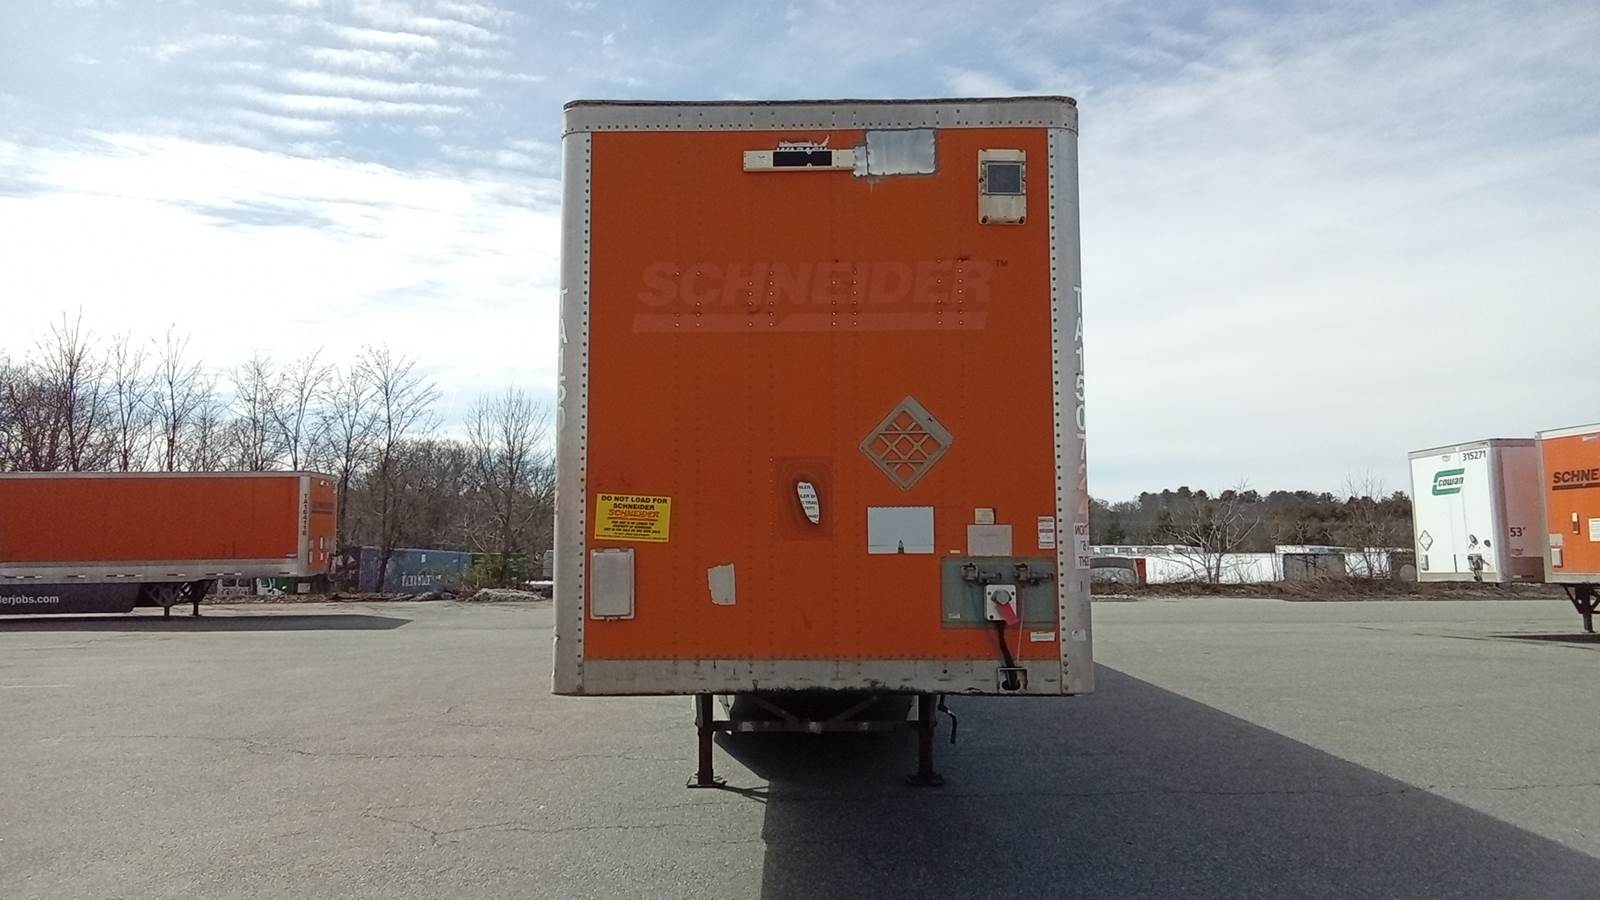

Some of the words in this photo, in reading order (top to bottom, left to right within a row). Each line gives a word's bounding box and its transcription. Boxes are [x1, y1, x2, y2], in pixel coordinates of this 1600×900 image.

[638, 260, 994, 307] SCHNEIDER
[1462, 450, 1487, 462] 315271
[1553, 467, 1599, 484] SCHNE
[613, 503, 655, 511] SCHNEIDER
